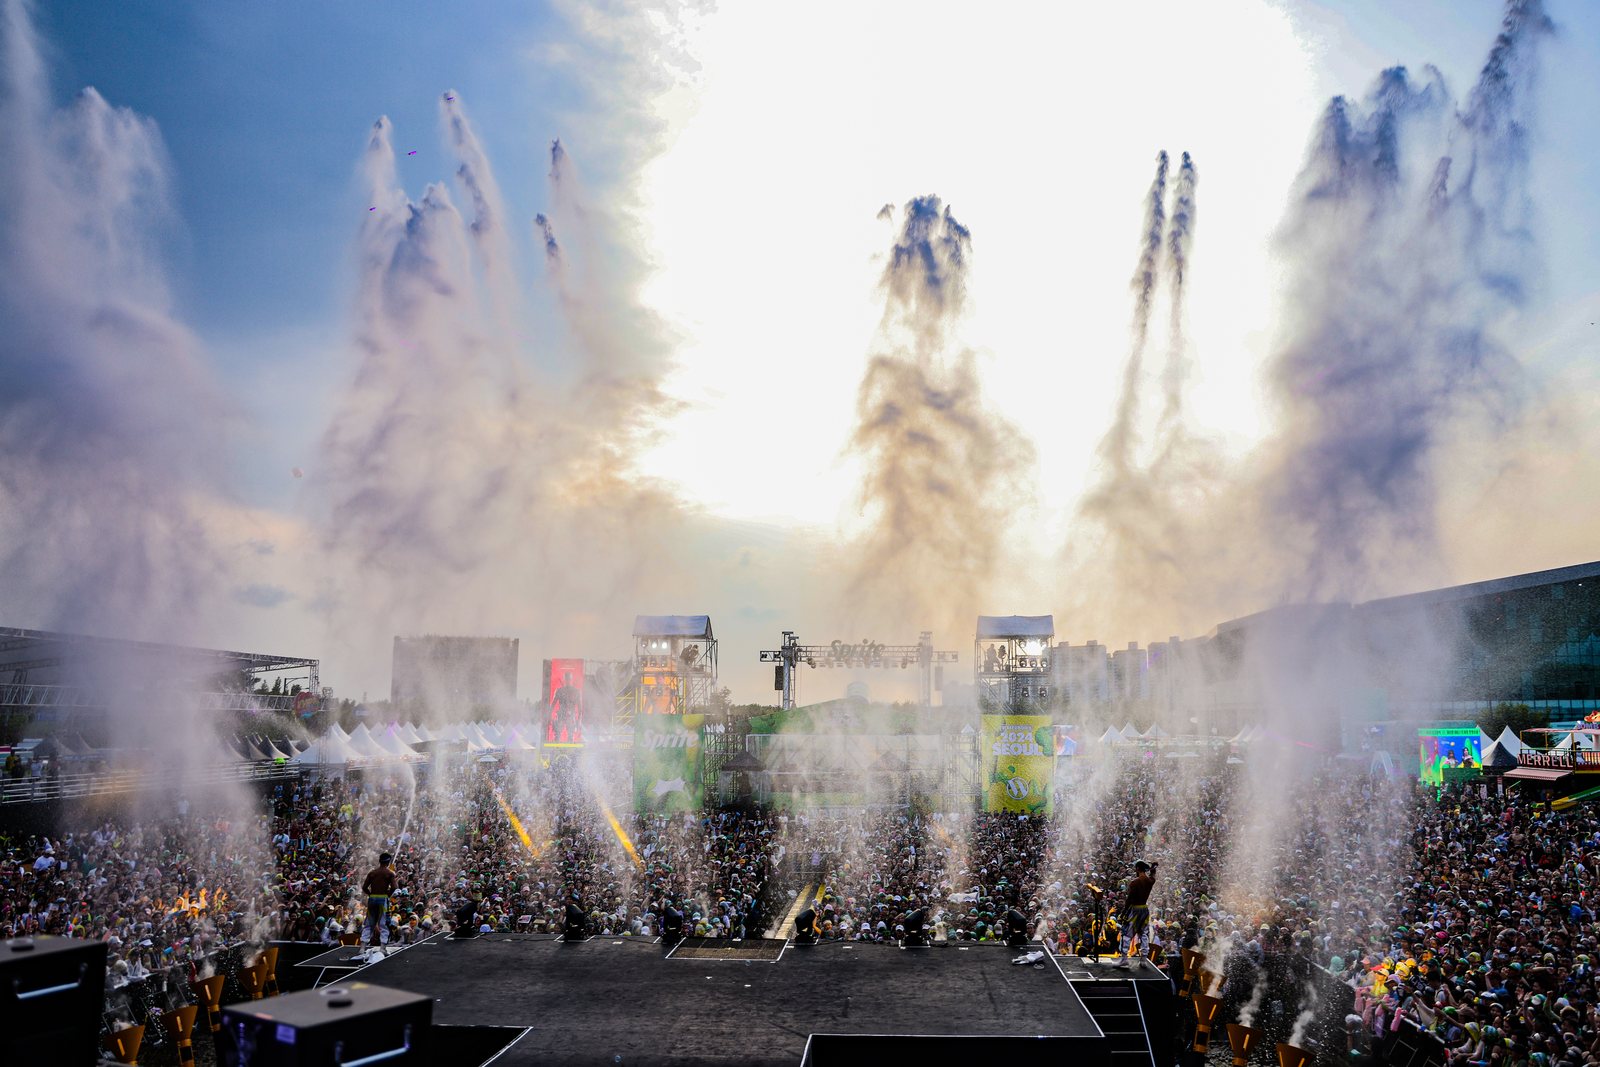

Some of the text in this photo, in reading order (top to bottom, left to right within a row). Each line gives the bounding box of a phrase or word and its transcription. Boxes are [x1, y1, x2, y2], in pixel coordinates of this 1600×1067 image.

[828, 639, 885, 662] Sprite
[640, 729, 699, 751] Sprite
[1000, 731, 1033, 743] 2024
[992, 742, 1043, 756] SEOUL
[1516, 753, 1574, 768] MERRELL
